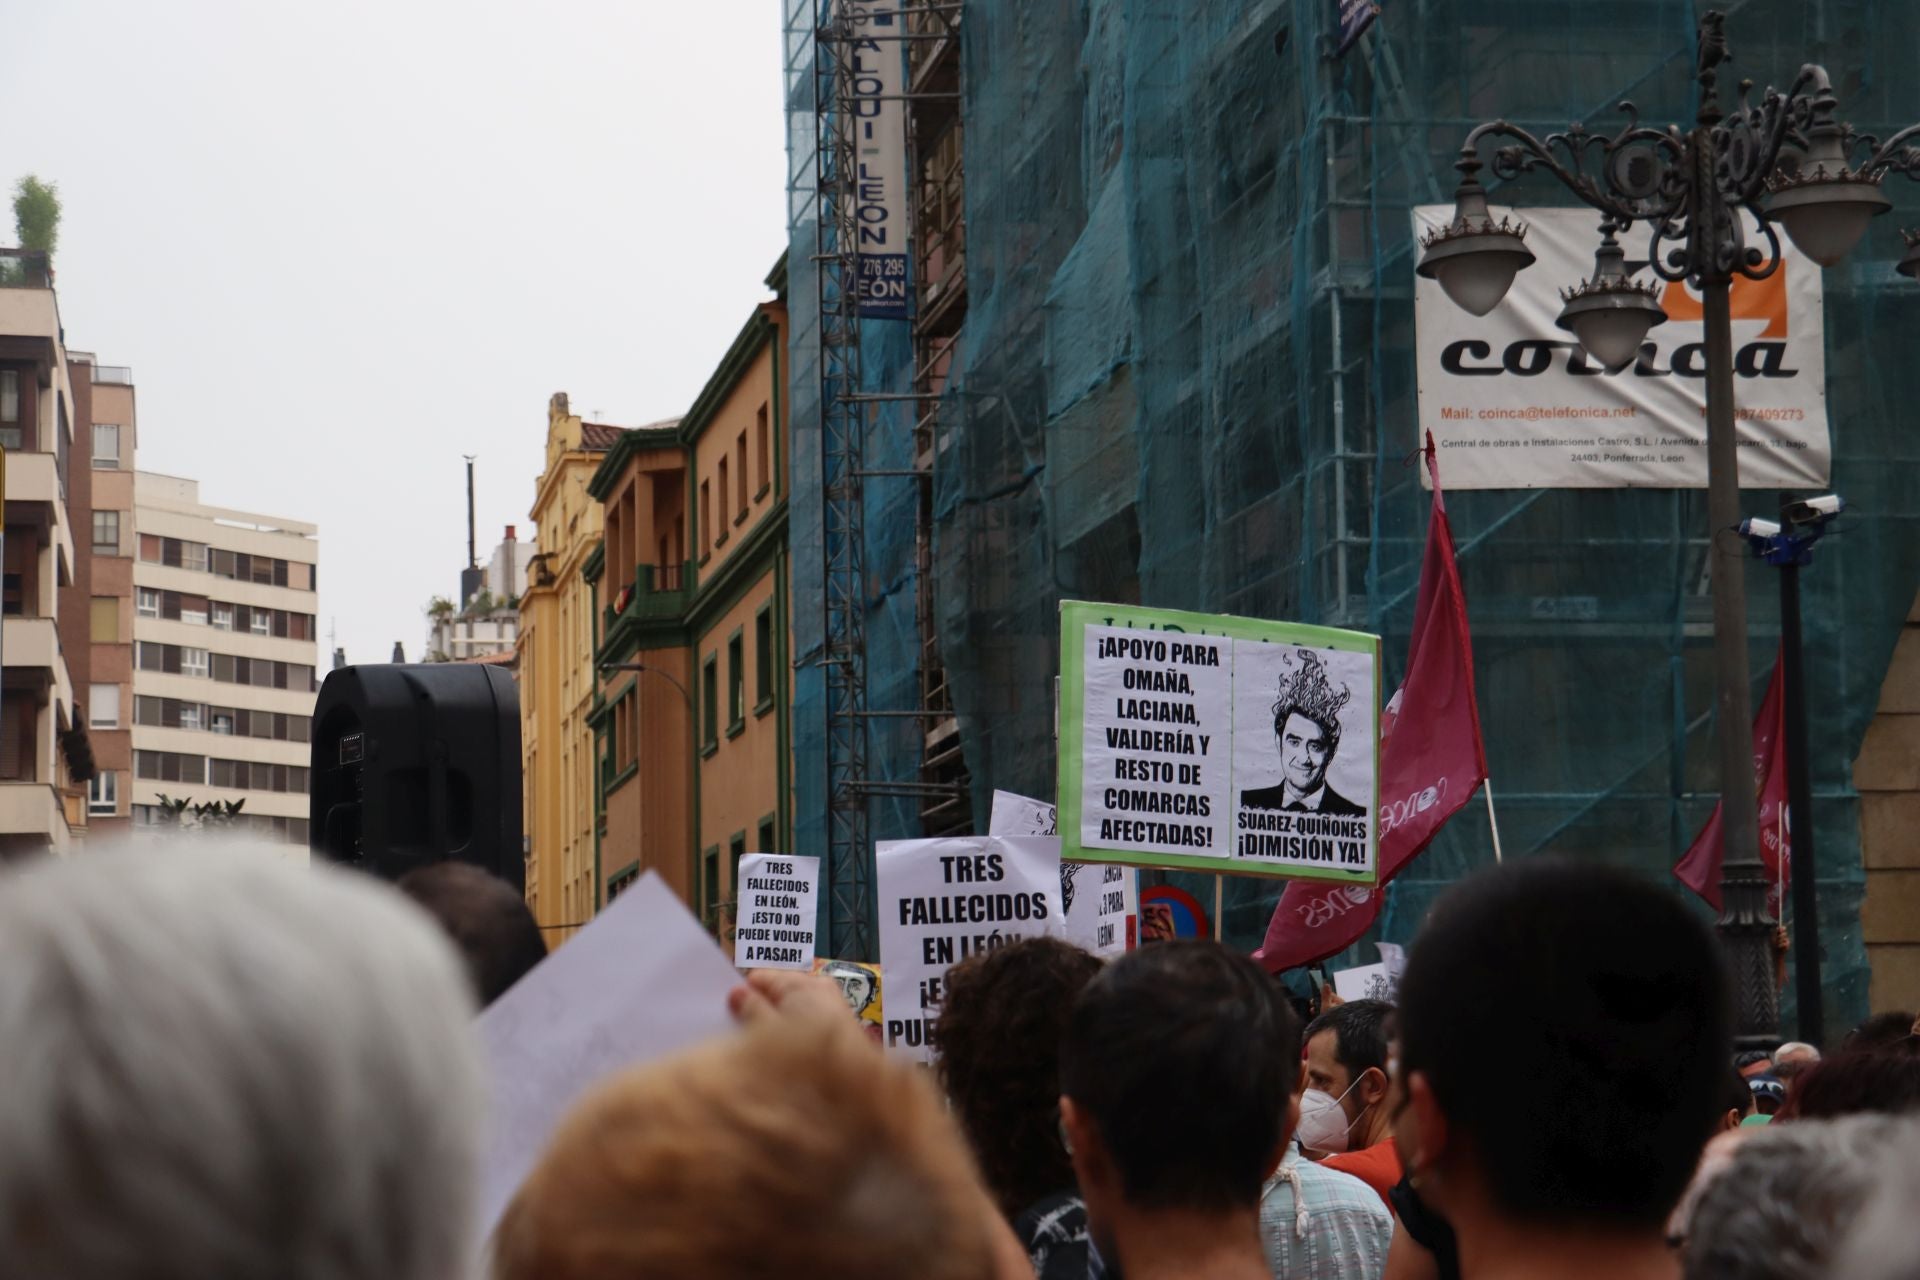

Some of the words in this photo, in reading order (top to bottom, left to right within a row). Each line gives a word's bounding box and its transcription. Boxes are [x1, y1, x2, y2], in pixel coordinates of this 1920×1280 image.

[885, 258, 905, 276] 295
[1441, 406, 1473, 420] Mail:
[1478, 405, 1636, 421] coinca@telefonica.net
[1441, 439, 1476, 449] Central
[1479, 438, 1490, 448] de
[1493, 438, 1520, 448] obras
[1660, 438, 1699, 448] Avenida
[1786, 439, 1808, 450] bajo
[1604, 453, 1657, 463] Ponferrada,
[1099, 637, 1166, 662] ¡APOYO
[1171, 643, 1219, 667] PARA
[1123, 668, 1195, 696] OMAÑA,
[1117, 698, 1201, 727] LACIANA,
[1106, 727, 1195, 755] VALDERÍA
[1199, 735, 1211, 756] Y
[1115, 758, 1174, 783] RESTO
[1178, 763, 1202, 785] DE
[1104, 788, 1211, 817] COMARCAS
[1100, 818, 1213, 848] AFECTADAS!
[1238, 812, 1367, 840] SUAREZ-QUIÑONES
[1238, 833, 1333, 861] ¡DIMISIÓN
[1338, 841, 1366, 865] YA!
[766, 862, 793, 875] TRES
[939, 854, 1004, 883] TRES
[747, 878, 809, 893] FALLECIDOS
[755, 895, 768, 907] EN
[770, 895, 800, 909] LEÓN.
[899, 892, 1048, 925] FALLECIDOS
[1108, 891, 1125, 915] PARA
[752, 912, 782, 925] ¡ESTO
[785, 914, 800, 926] NO
[738, 928, 770, 941] PUEDE
[773, 930, 813, 944] VOLVER
[1098, 922, 1115, 948] LEÓN!
[746, 946, 754, 960] A
[757, 947, 802, 963] PASAR!
[923, 937, 954, 965] EN
[888, 1019, 938, 1048] PUE
